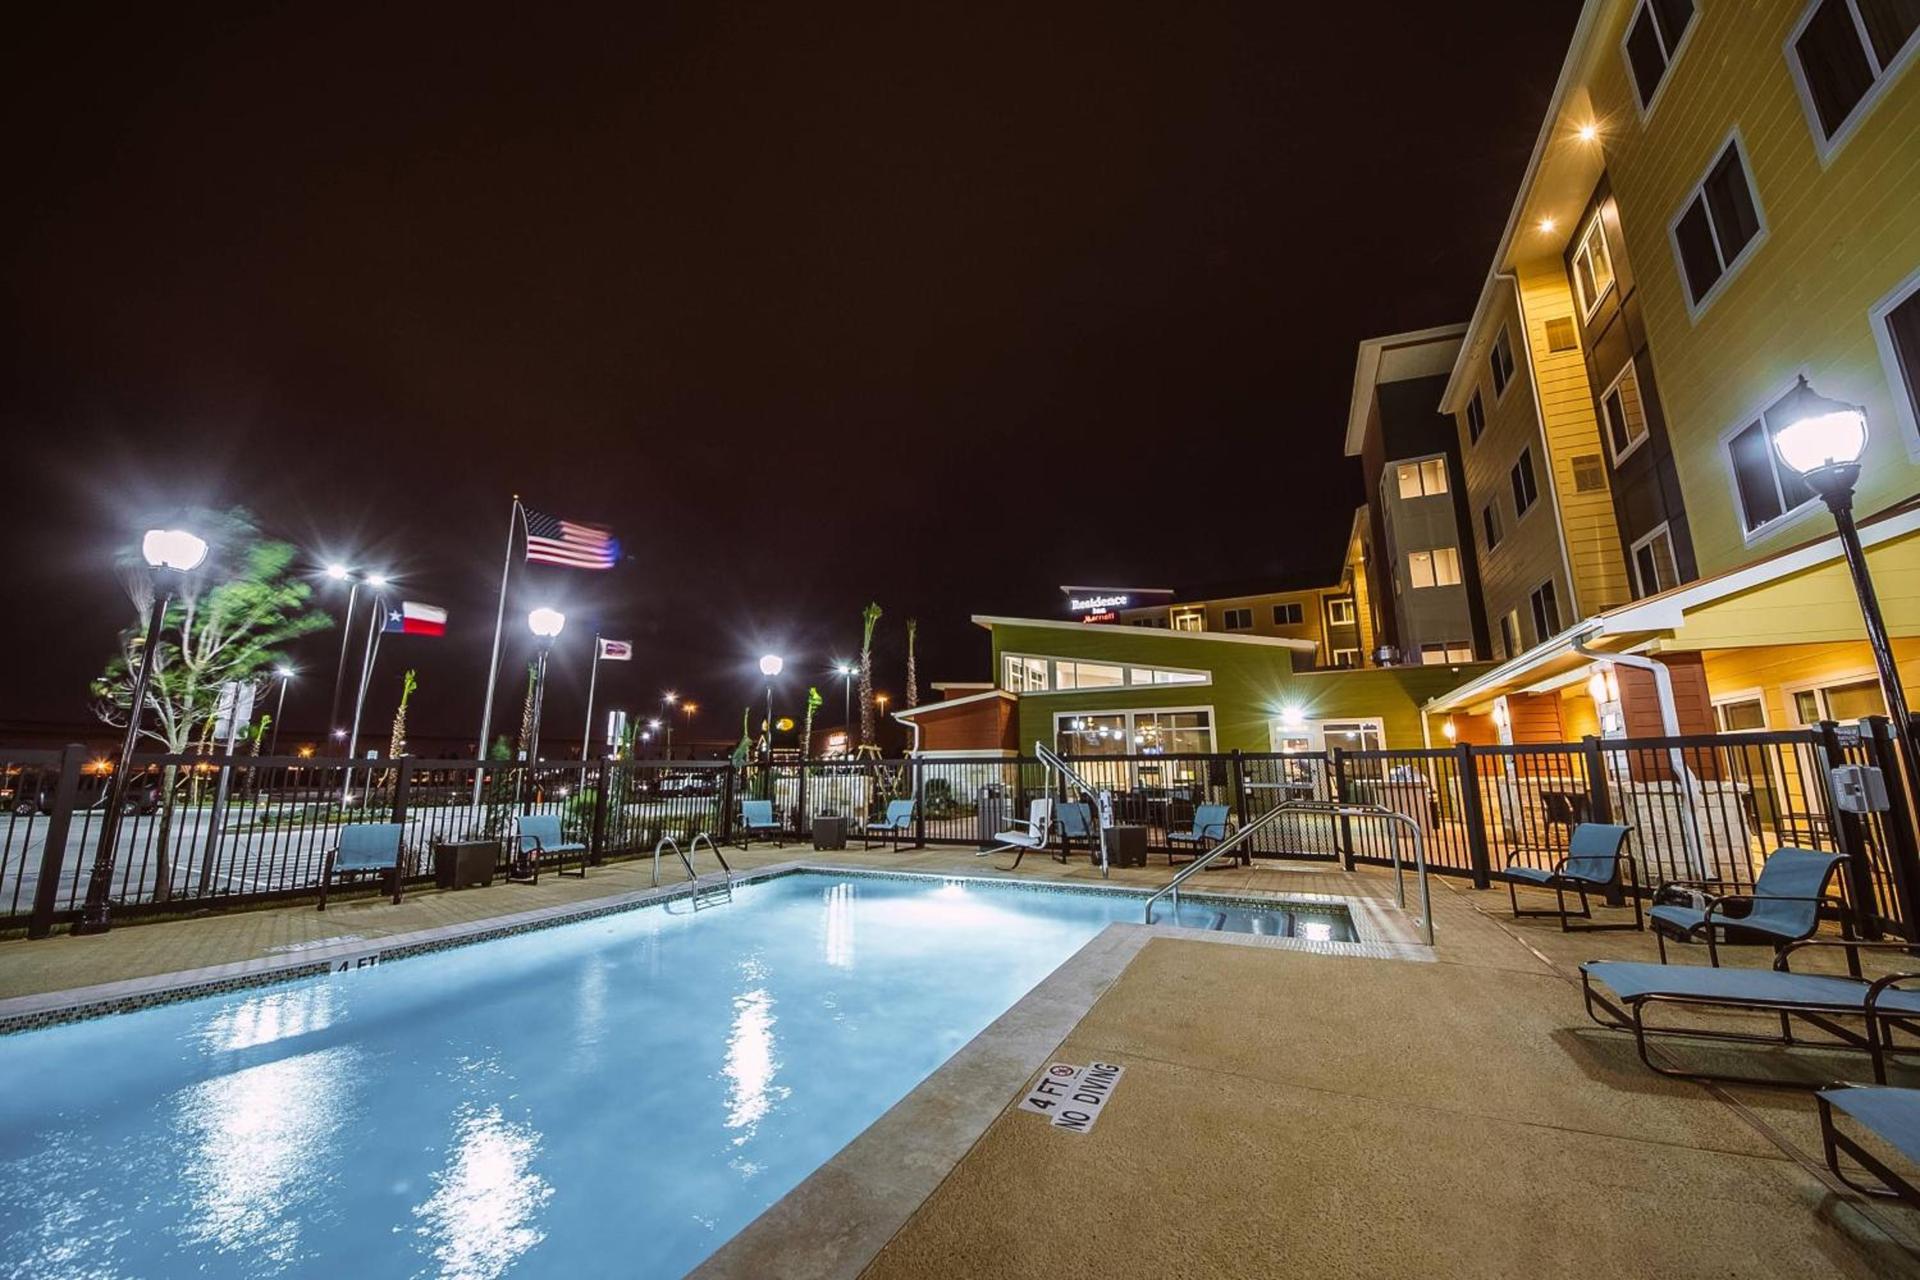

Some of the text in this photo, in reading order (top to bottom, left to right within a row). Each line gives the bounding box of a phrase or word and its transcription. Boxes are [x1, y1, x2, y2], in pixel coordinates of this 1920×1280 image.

[1071, 596, 1127, 610] Residence
[1092, 607, 1107, 615] Inn
[357, 955, 378, 969] FT
[1029, 1077, 1069, 1110] 4 FT
[1055, 1063, 1120, 1131] NO DIVING
